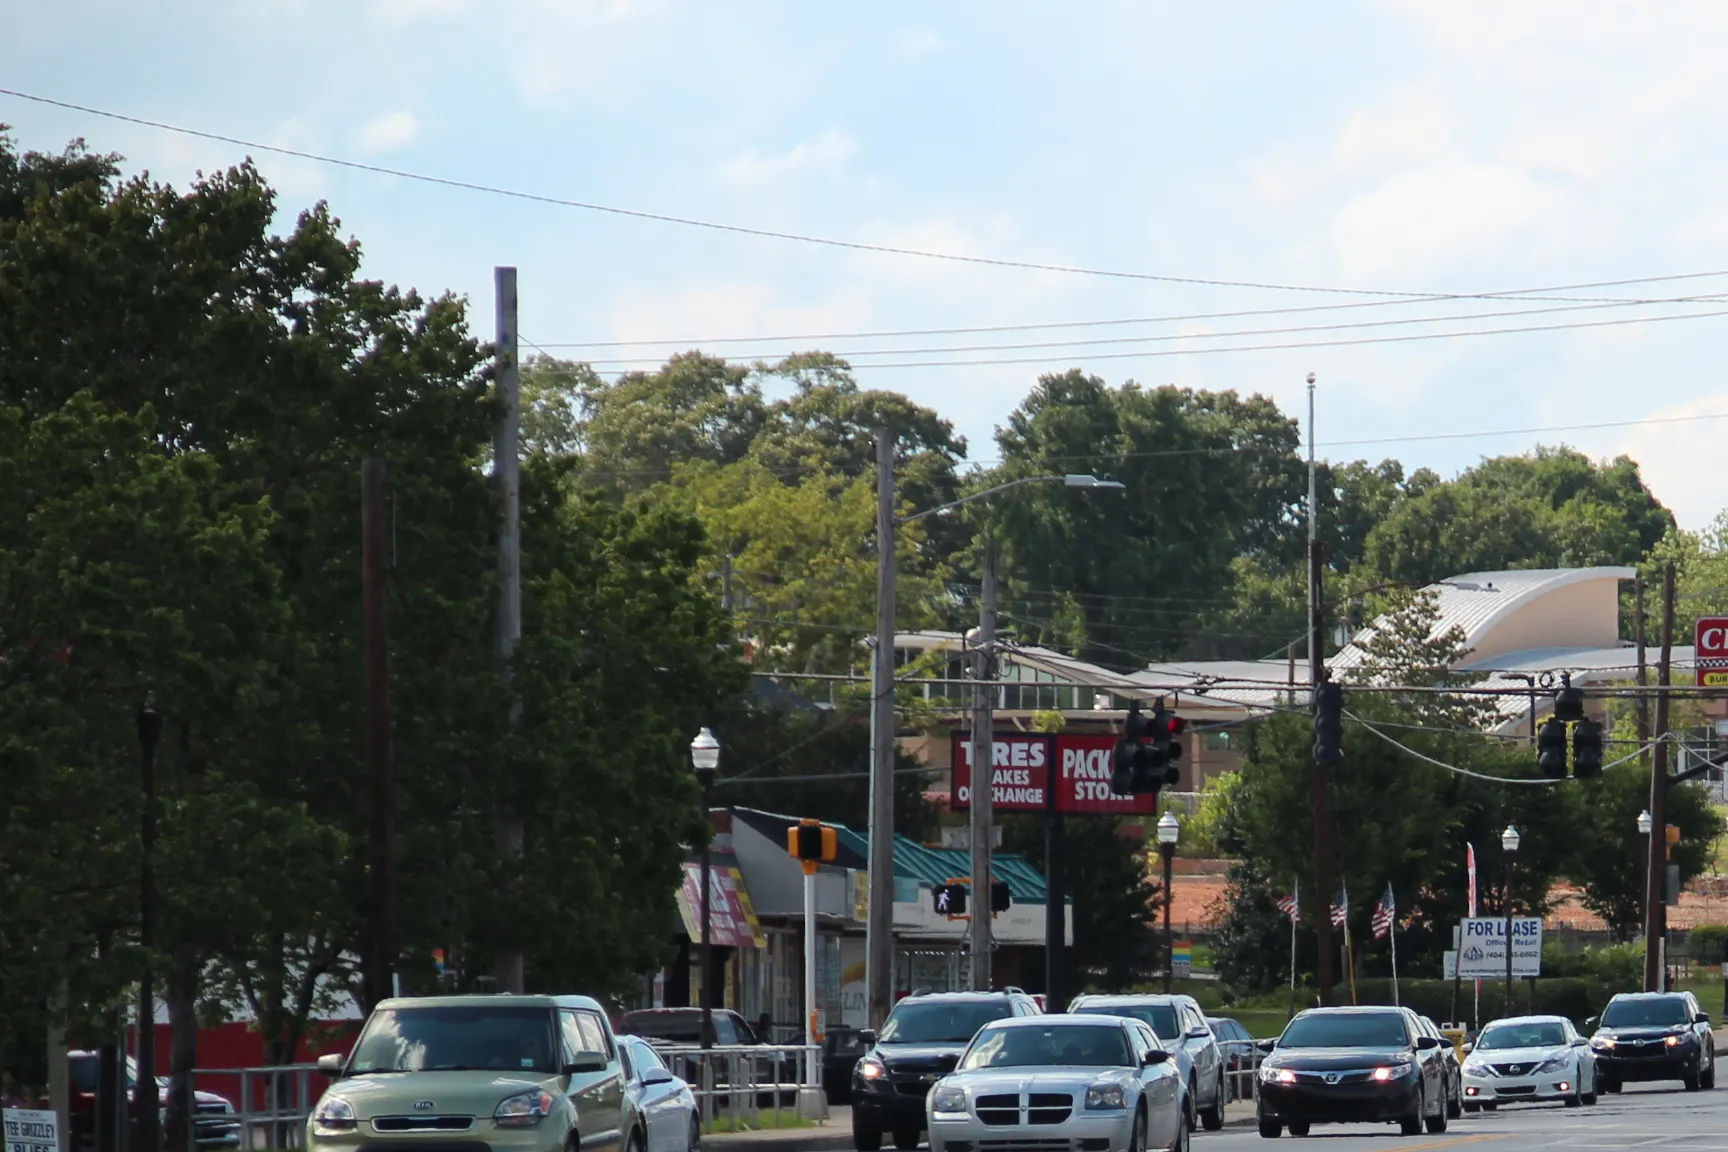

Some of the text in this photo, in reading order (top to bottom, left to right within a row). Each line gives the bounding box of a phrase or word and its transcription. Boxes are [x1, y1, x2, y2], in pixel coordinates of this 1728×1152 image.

[961, 742, 1045, 767] TRES
[1467, 921, 1538, 937] FOR LASE
